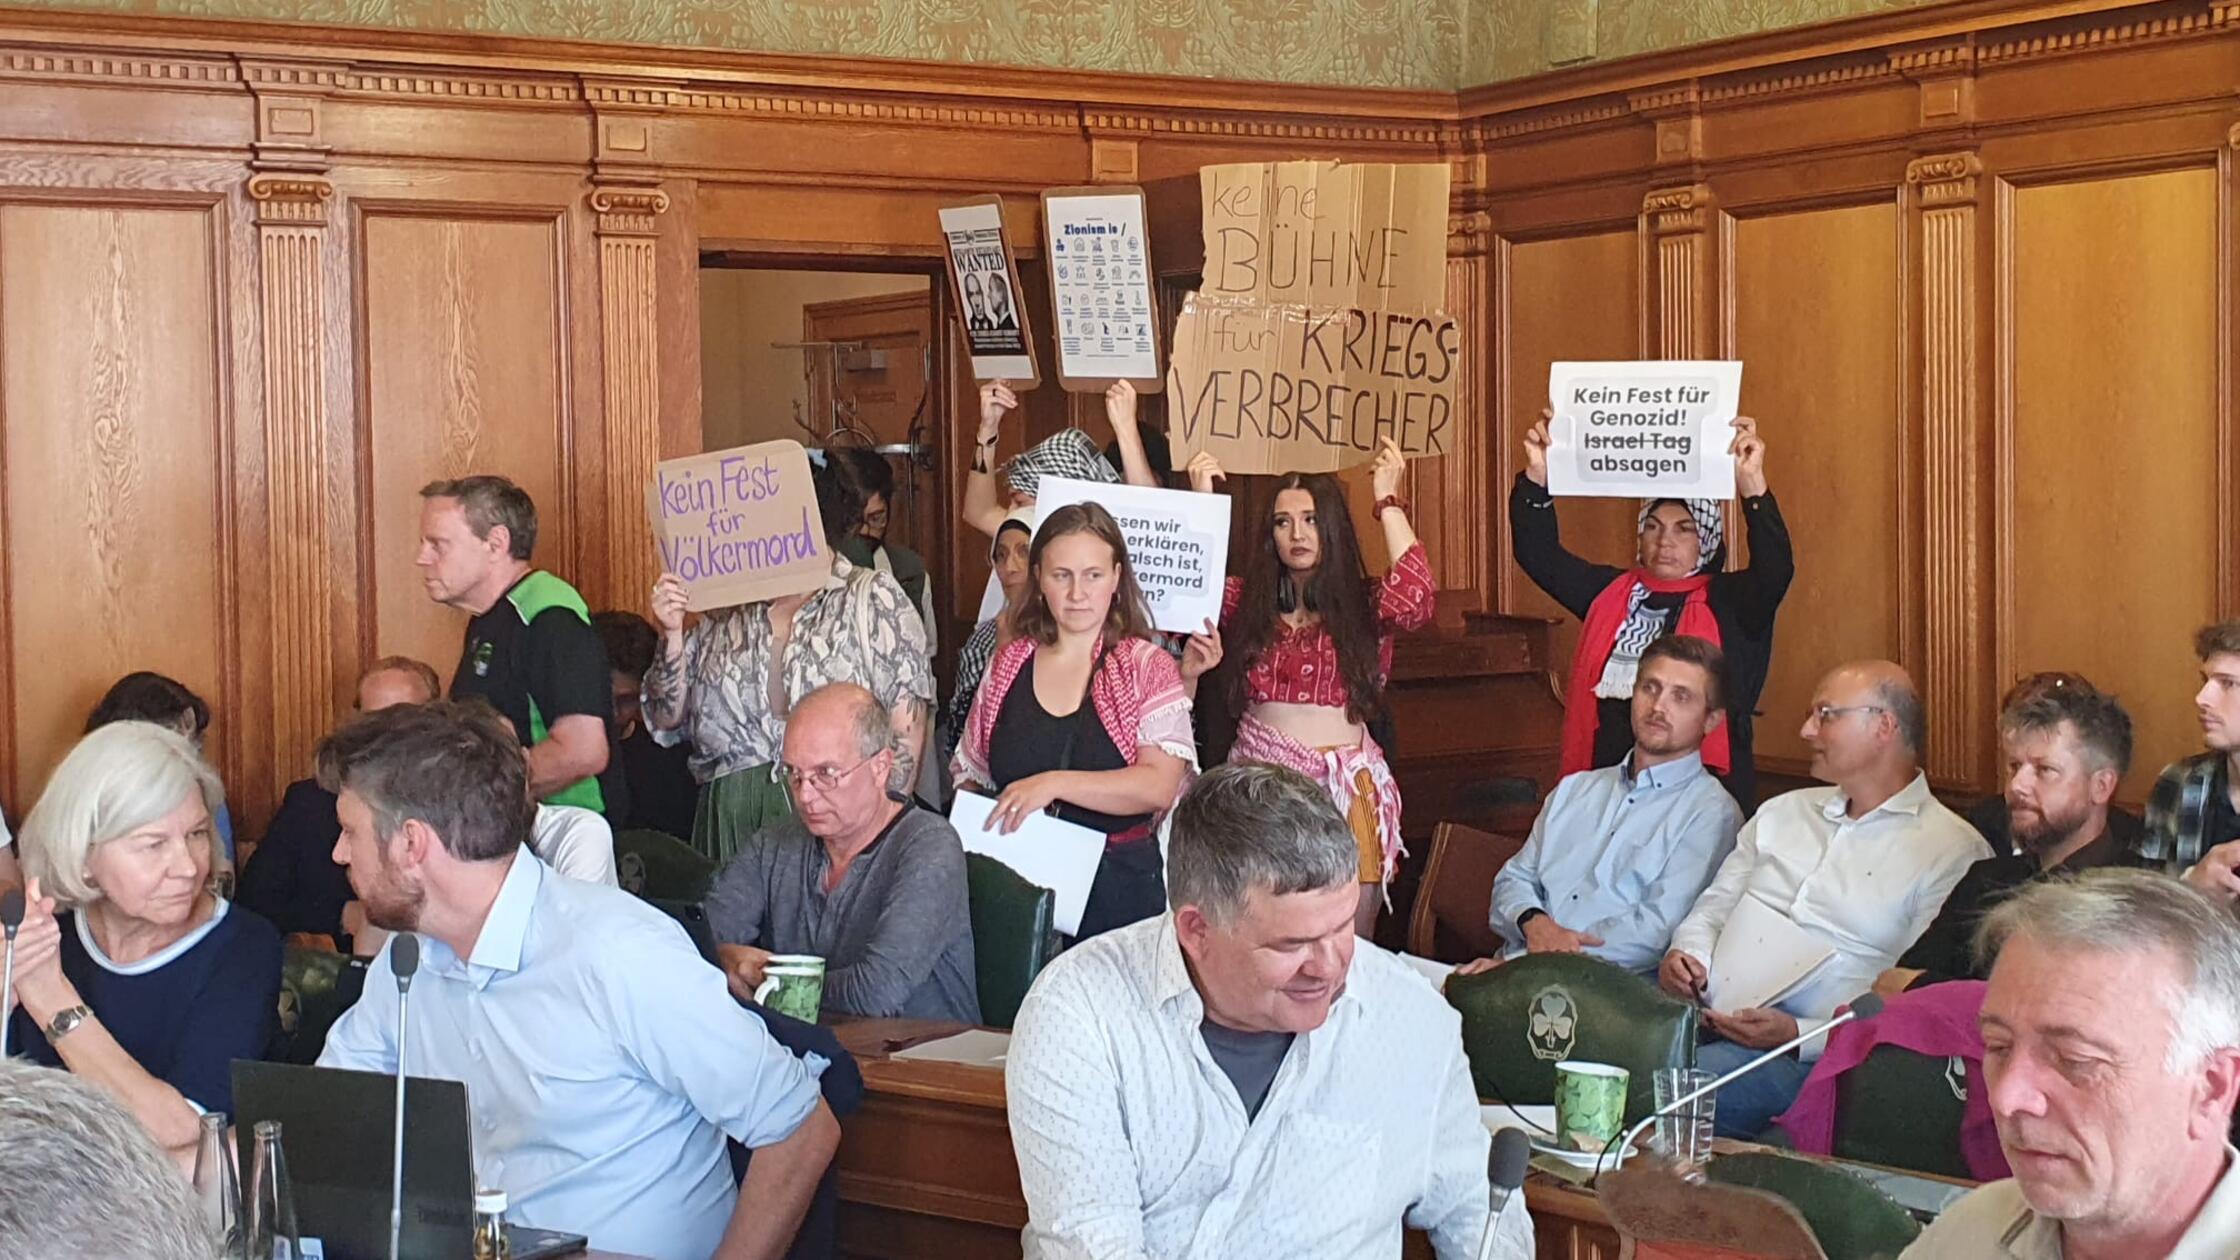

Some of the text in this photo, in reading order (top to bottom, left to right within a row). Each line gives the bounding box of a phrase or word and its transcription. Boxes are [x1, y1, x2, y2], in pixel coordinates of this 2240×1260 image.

[1212, 169, 1327, 221] keine
[1064, 223, 1106, 235] Zionism
[1108, 222, 1118, 234] is
[953, 252, 1005, 274] WANTED
[1216, 223, 1408, 293] BÜHNE
[1213, 314, 1277, 353] für
[1573, 385, 1711, 404] Kein Fest für
[1173, 368, 1451, 455] VERBRECHER
[1590, 408, 1687, 427] Genozid!
[1584, 432, 1692, 455] Israel Tag
[1590, 455, 1687, 477] absagen
[719, 455, 780, 504] Fest
[706, 507, 746, 537] für
[1155, 518, 1182, 533] wir
[659, 506, 818, 582] Völkermord
[1127, 534, 1205, 556] erklären,
[1128, 551, 1203, 573] alsch ist,
[1133, 571, 1204, 588] ermord
